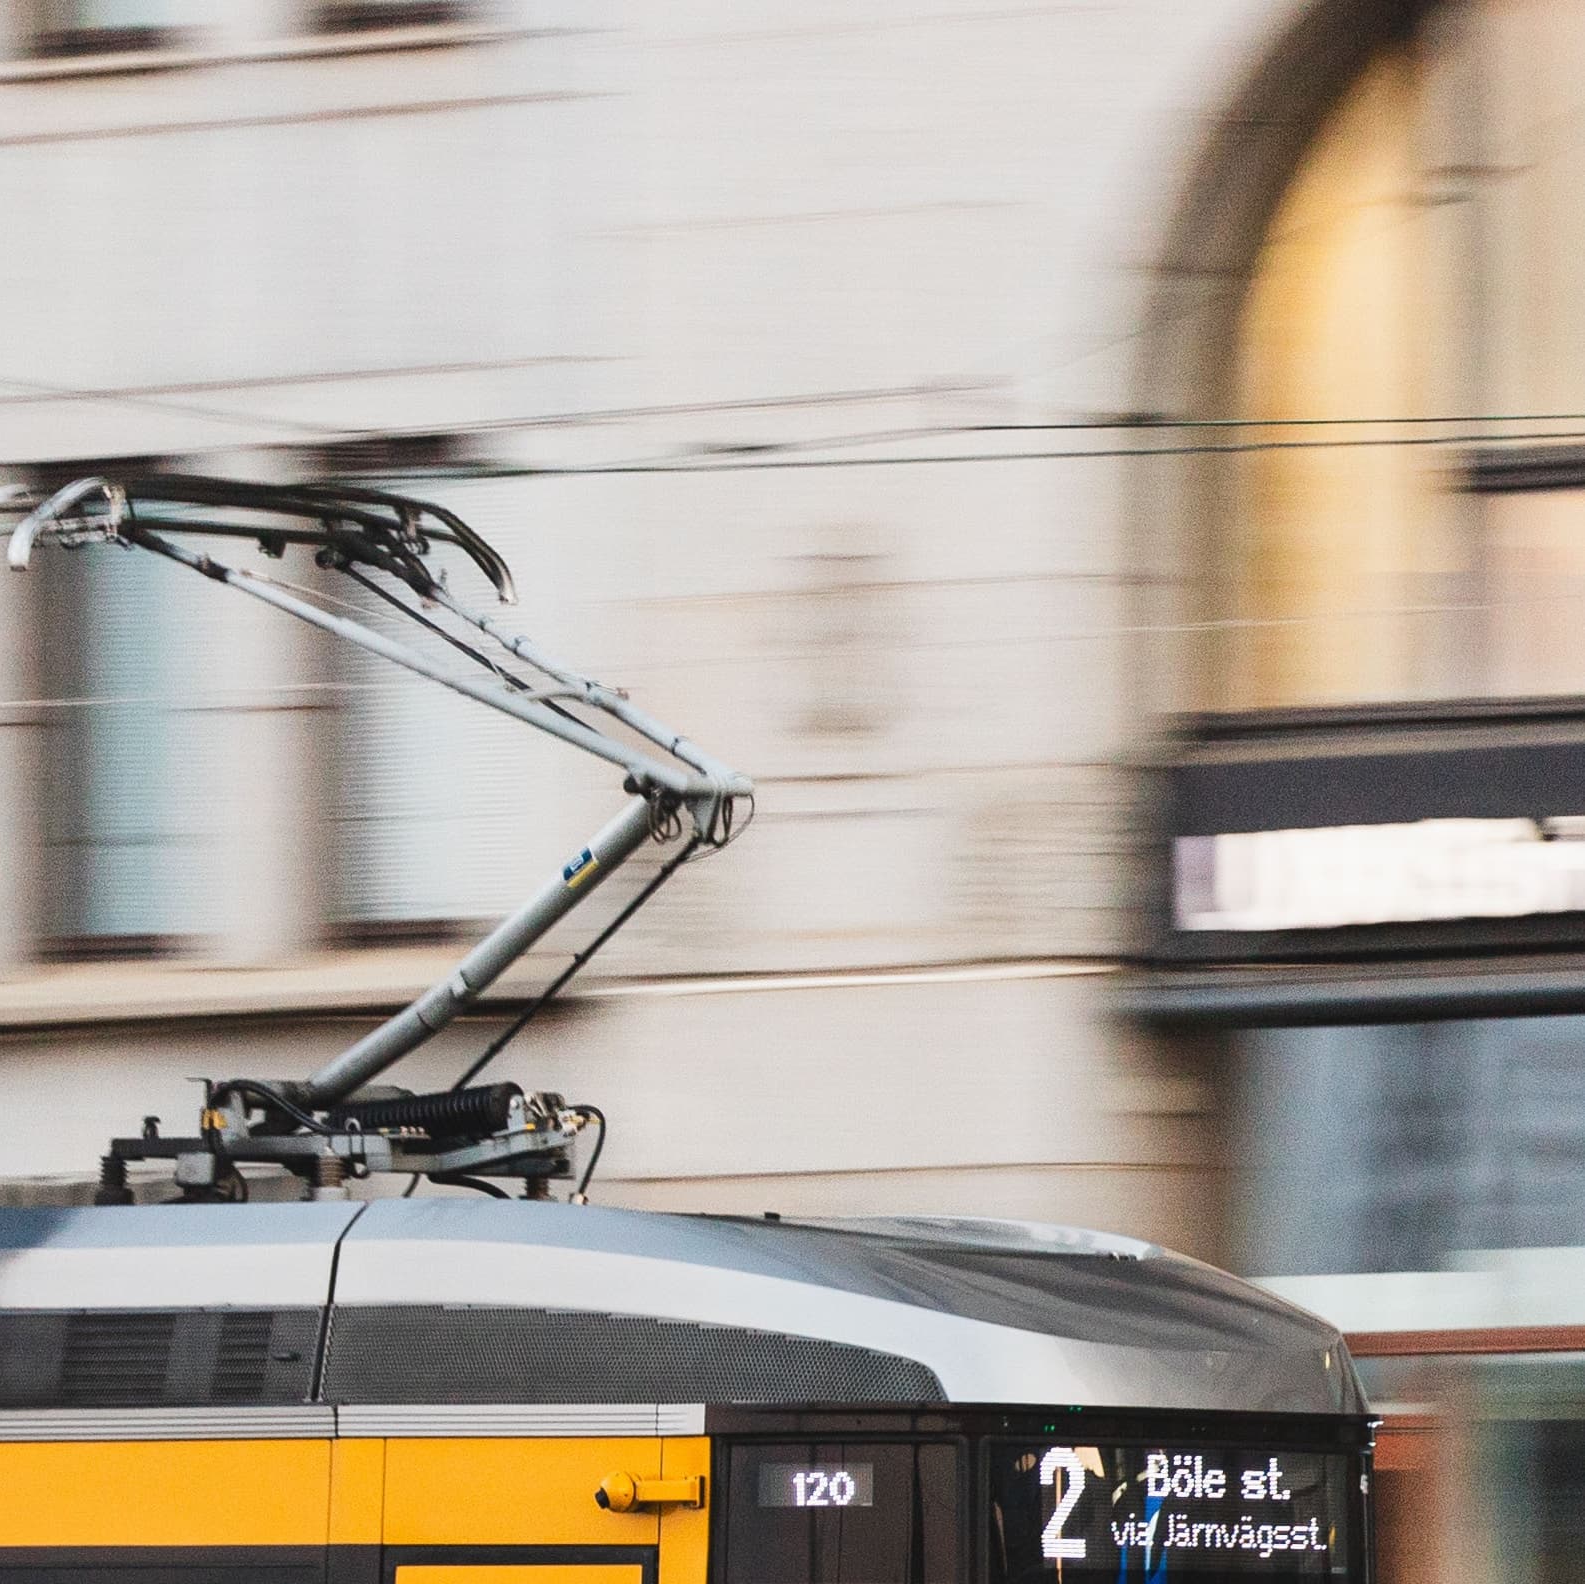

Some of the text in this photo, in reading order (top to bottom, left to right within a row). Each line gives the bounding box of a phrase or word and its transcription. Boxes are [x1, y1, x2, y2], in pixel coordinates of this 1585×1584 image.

[793, 1472, 855, 1506] 120
[1146, 1454, 1291, 1500] Böle st.
[1040, 1447, 1086, 1558] 2
[1111, 1513, 1154, 1546] via
